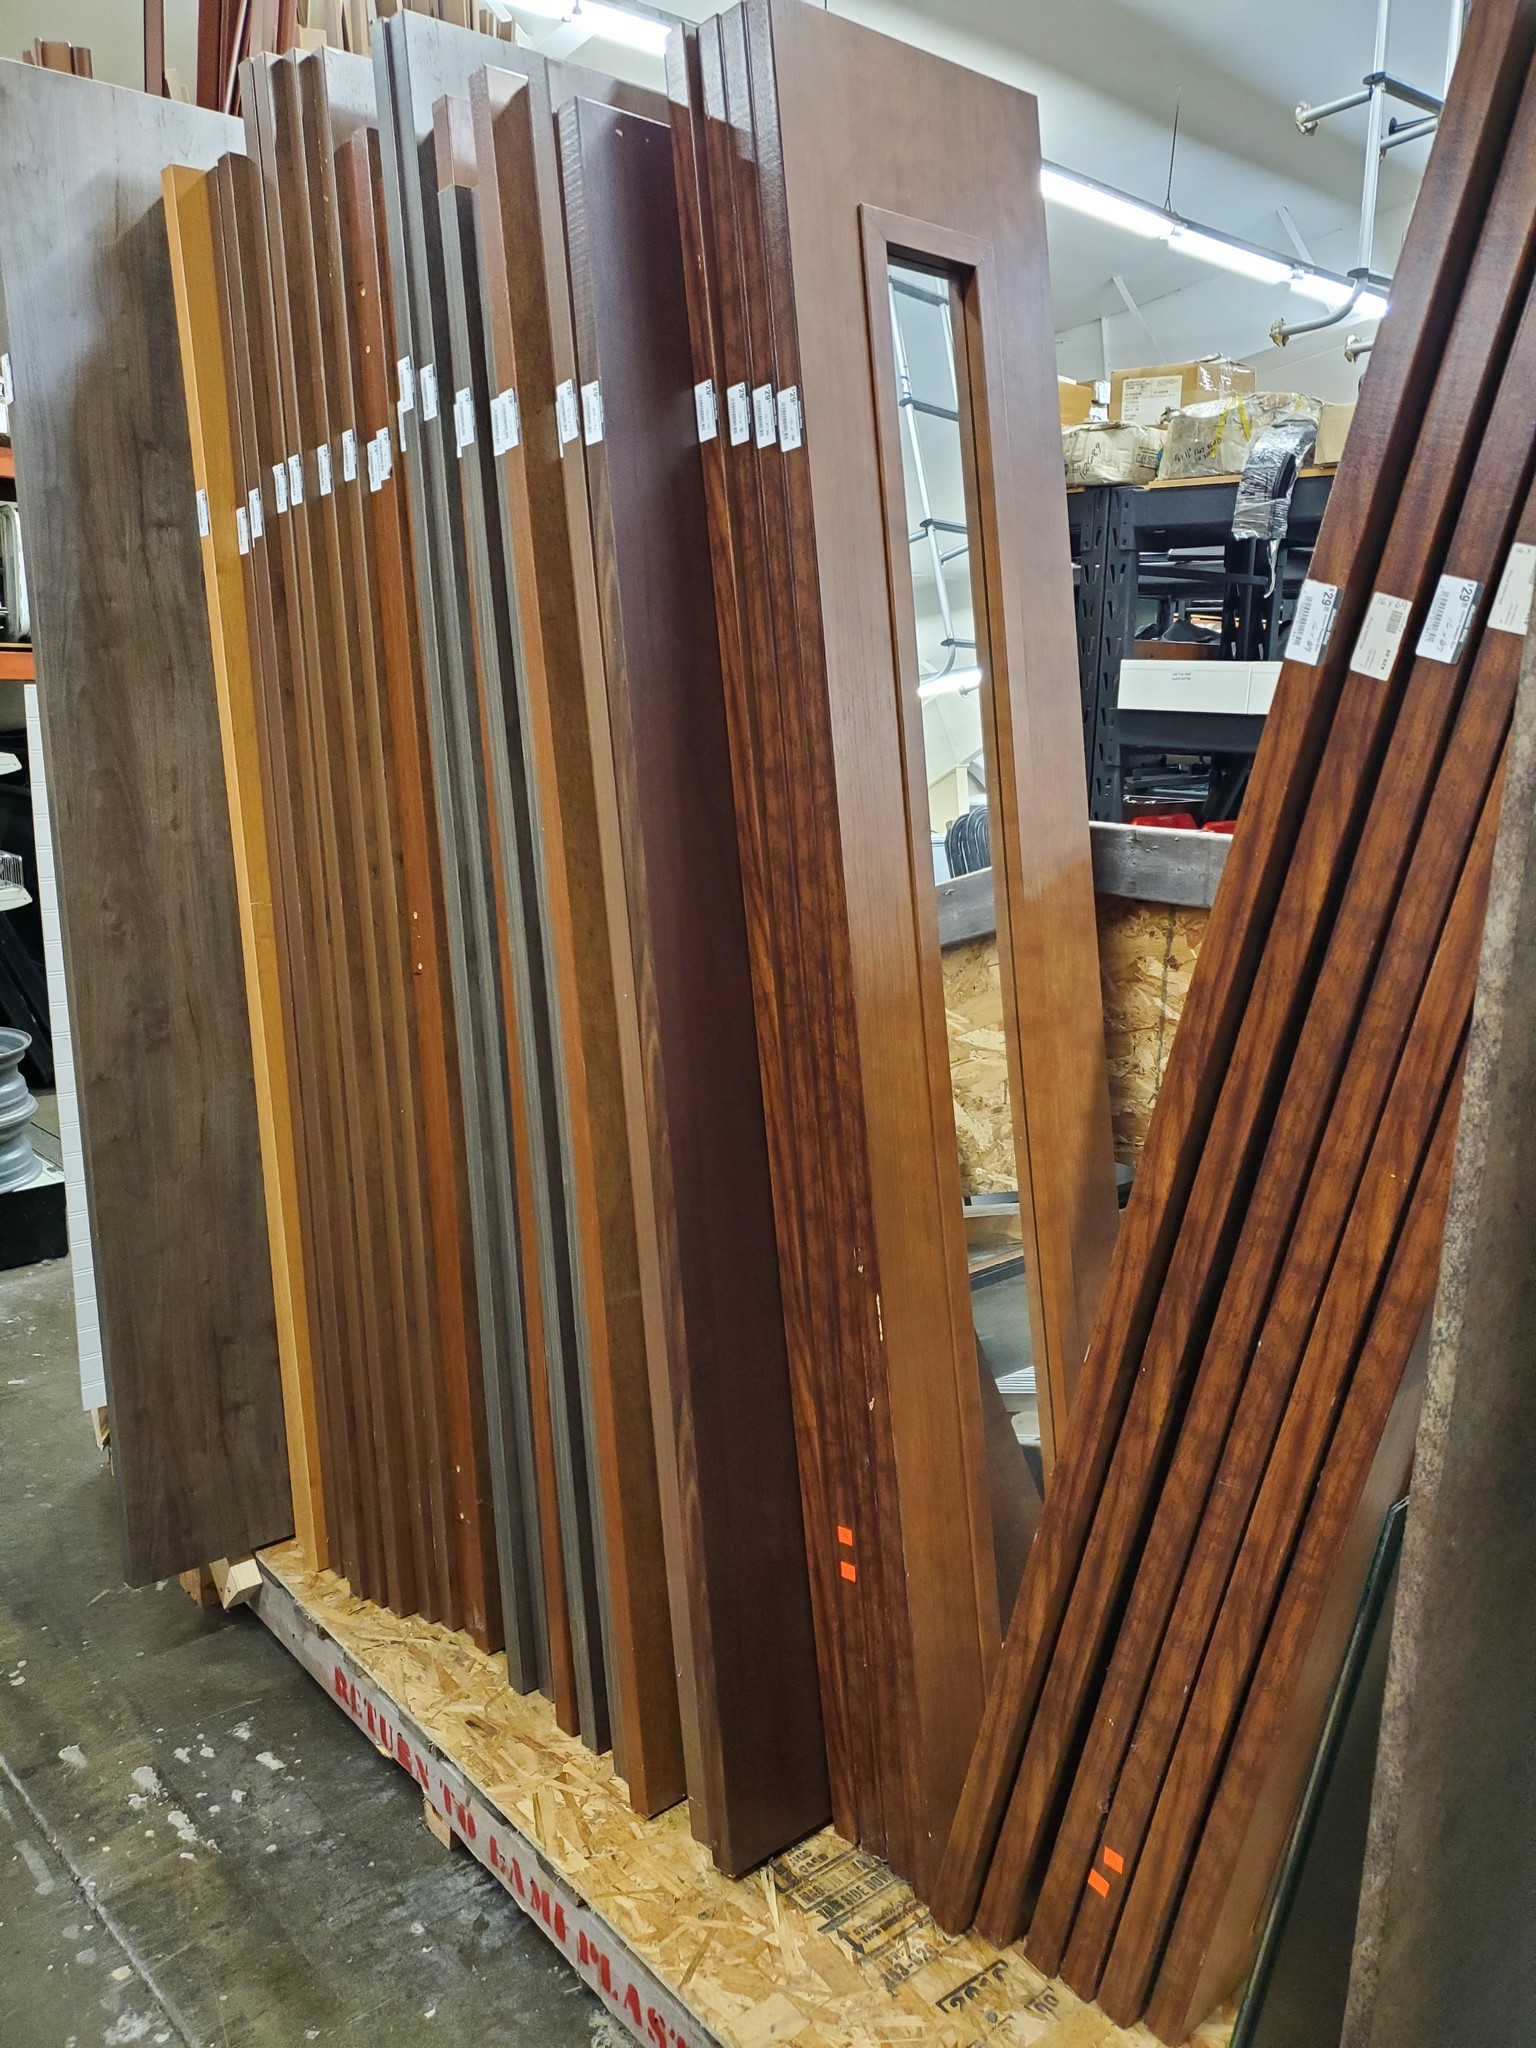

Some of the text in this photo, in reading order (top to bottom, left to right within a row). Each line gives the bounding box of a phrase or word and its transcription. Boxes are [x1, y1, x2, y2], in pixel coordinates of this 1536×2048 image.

[335, 1666, 429, 1790] RETURN
[440, 1779, 476, 1840] TO
[840, 1885, 870, 1906] SIDE
